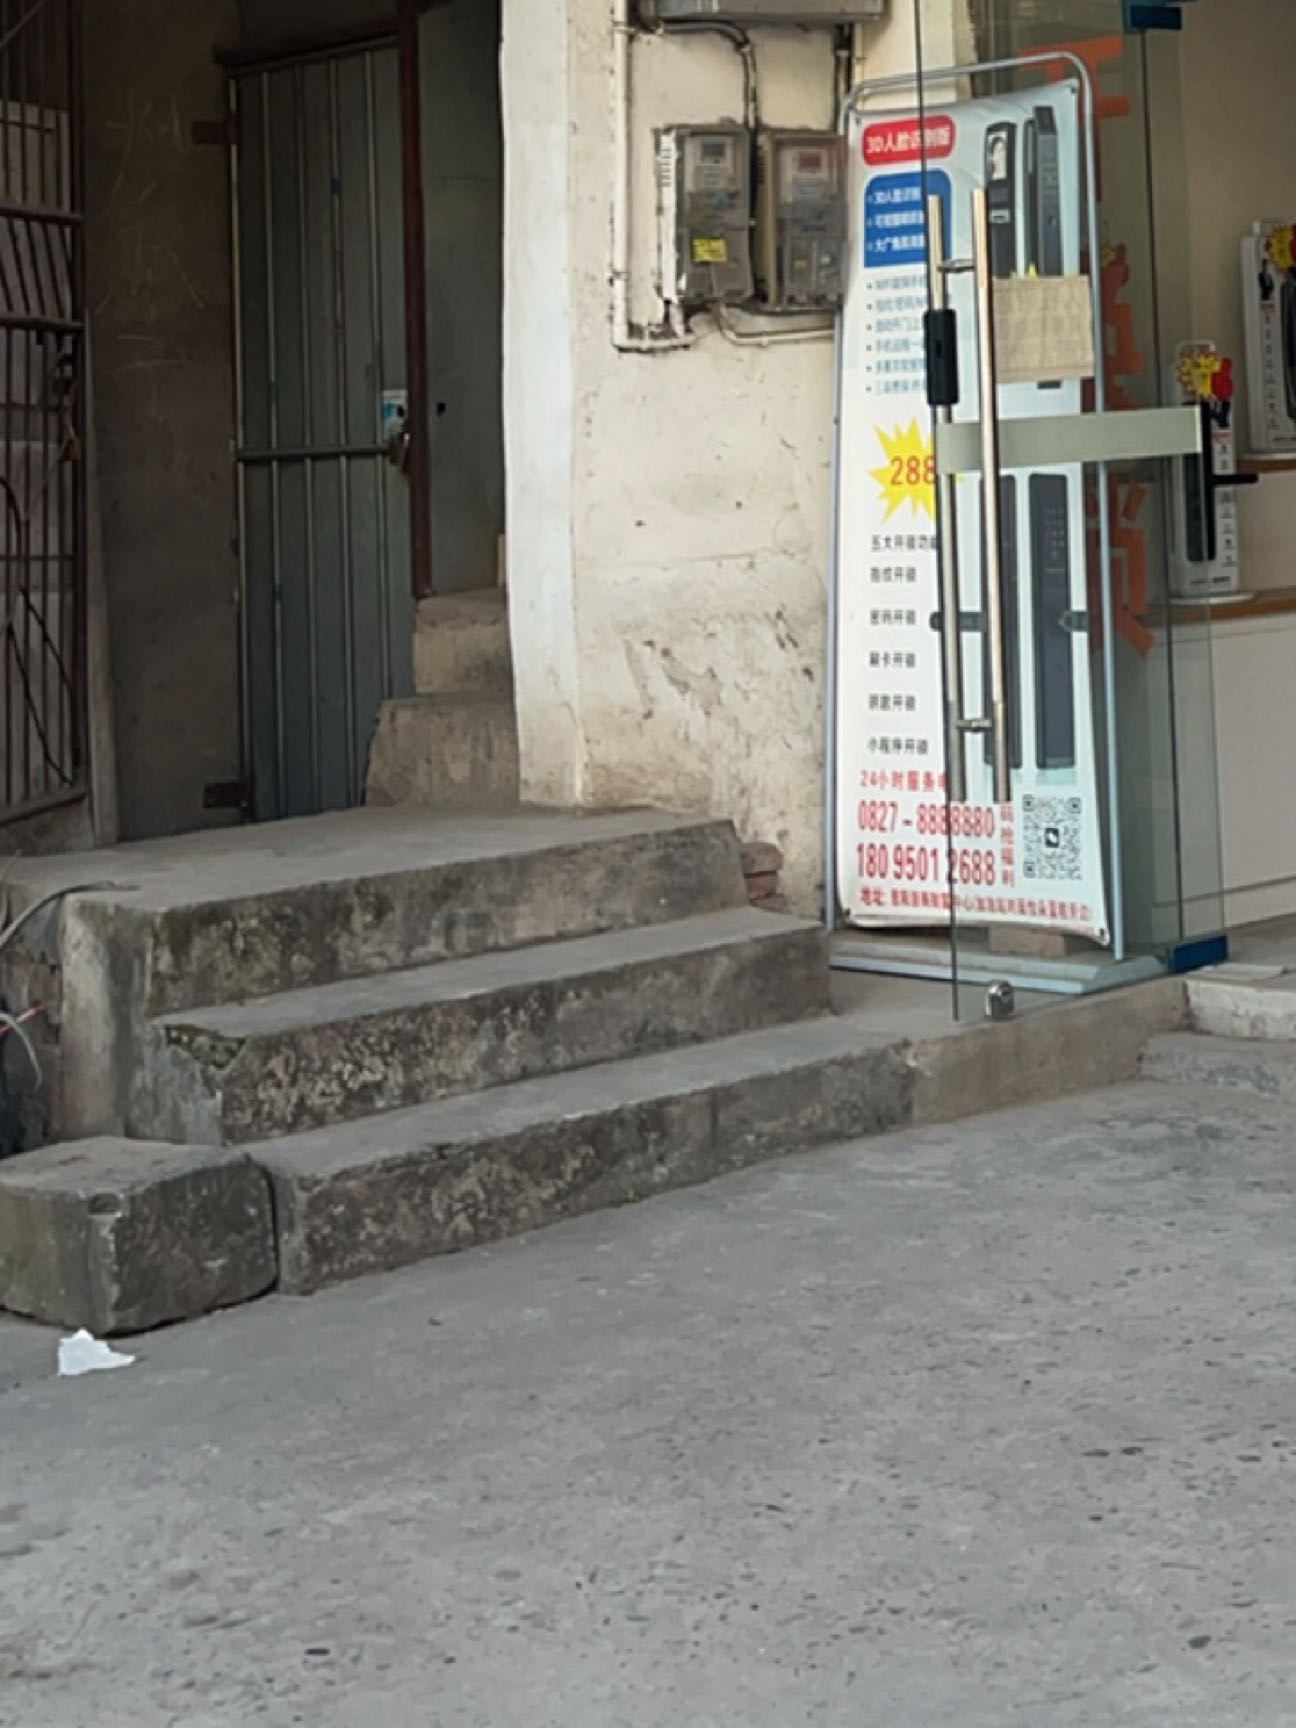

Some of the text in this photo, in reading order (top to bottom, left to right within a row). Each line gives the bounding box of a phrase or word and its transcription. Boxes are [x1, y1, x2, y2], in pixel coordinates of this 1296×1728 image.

[857, 842, 996, 886] 180 9501 2688
